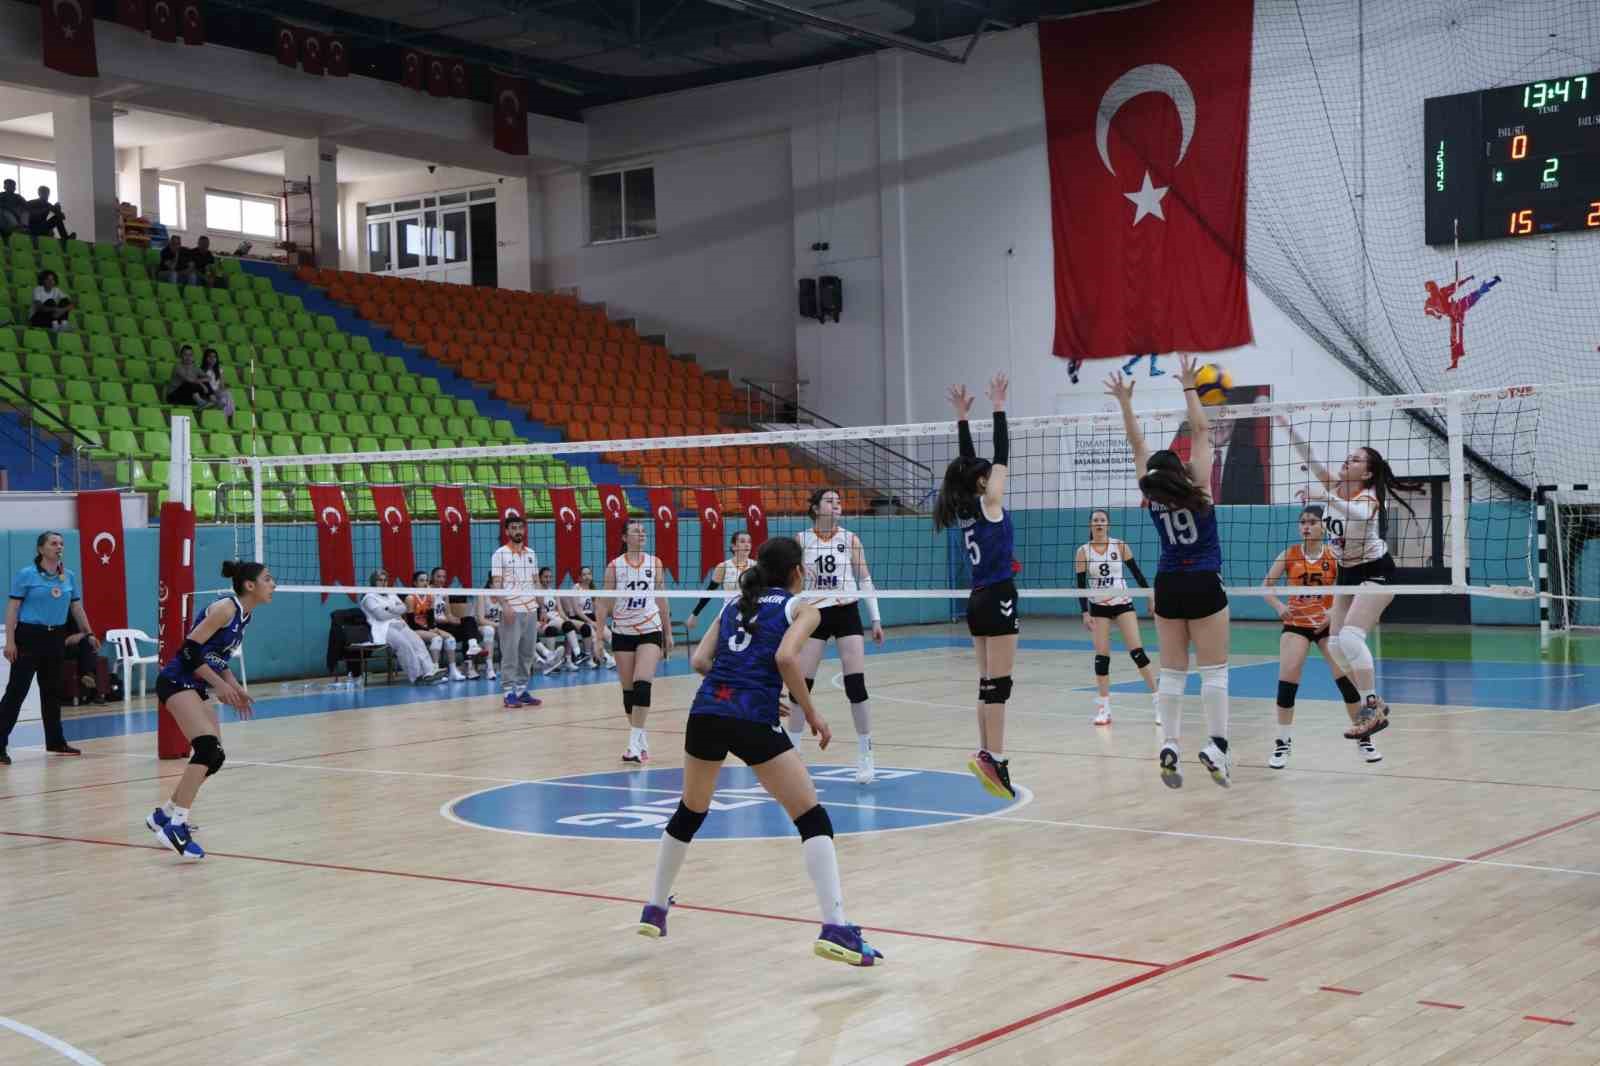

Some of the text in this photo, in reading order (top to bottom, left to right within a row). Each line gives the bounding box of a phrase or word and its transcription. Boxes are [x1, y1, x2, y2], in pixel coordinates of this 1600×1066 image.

[1523, 76, 1588, 108] 13:47
[1512, 135, 1527, 158] 0
[1543, 158, 1559, 182] 2
[1510, 210, 1533, 233] 15
[1160, 508, 1198, 544] 19
[964, 528, 981, 566] 5
[814, 554, 836, 574] 18
[1099, 563, 1110, 577] 8
